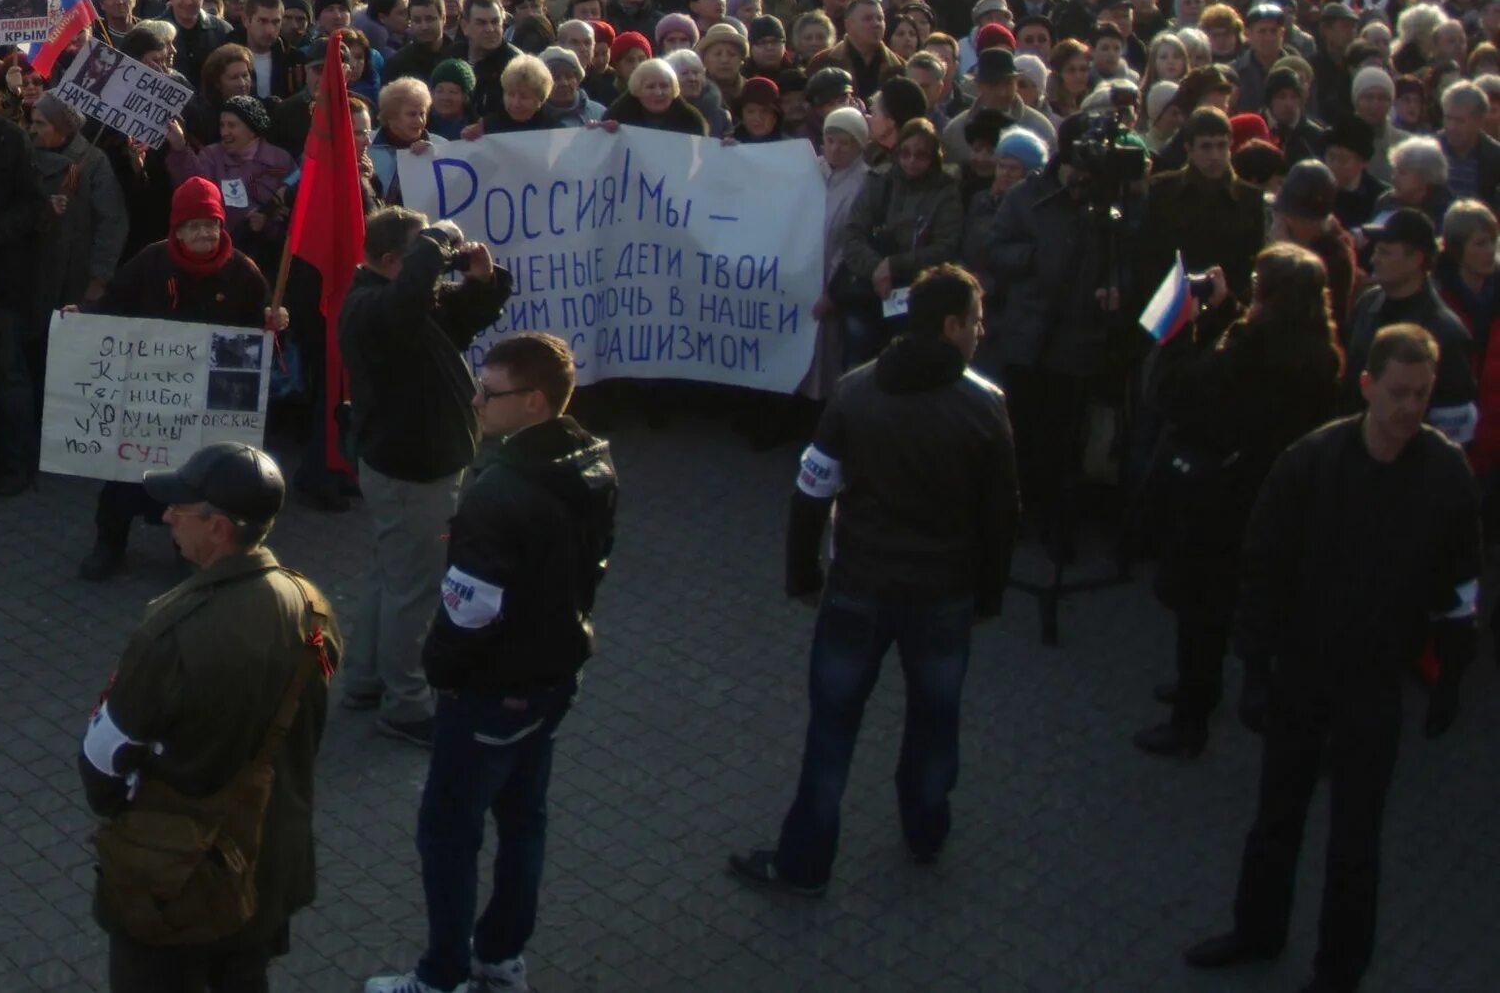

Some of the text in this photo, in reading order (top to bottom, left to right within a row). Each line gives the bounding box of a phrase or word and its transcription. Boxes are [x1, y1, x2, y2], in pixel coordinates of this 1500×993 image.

[5, 30, 46, 42] КРЫМ
[122, 65, 137, 82] С
[104, 107, 126, 128] ПО
[126, 119, 165, 149] ПУТИ
[614, 242, 682, 279] ДЕТИ
[669, 286, 684, 316] В
[118, 442, 169, 466] СУД
